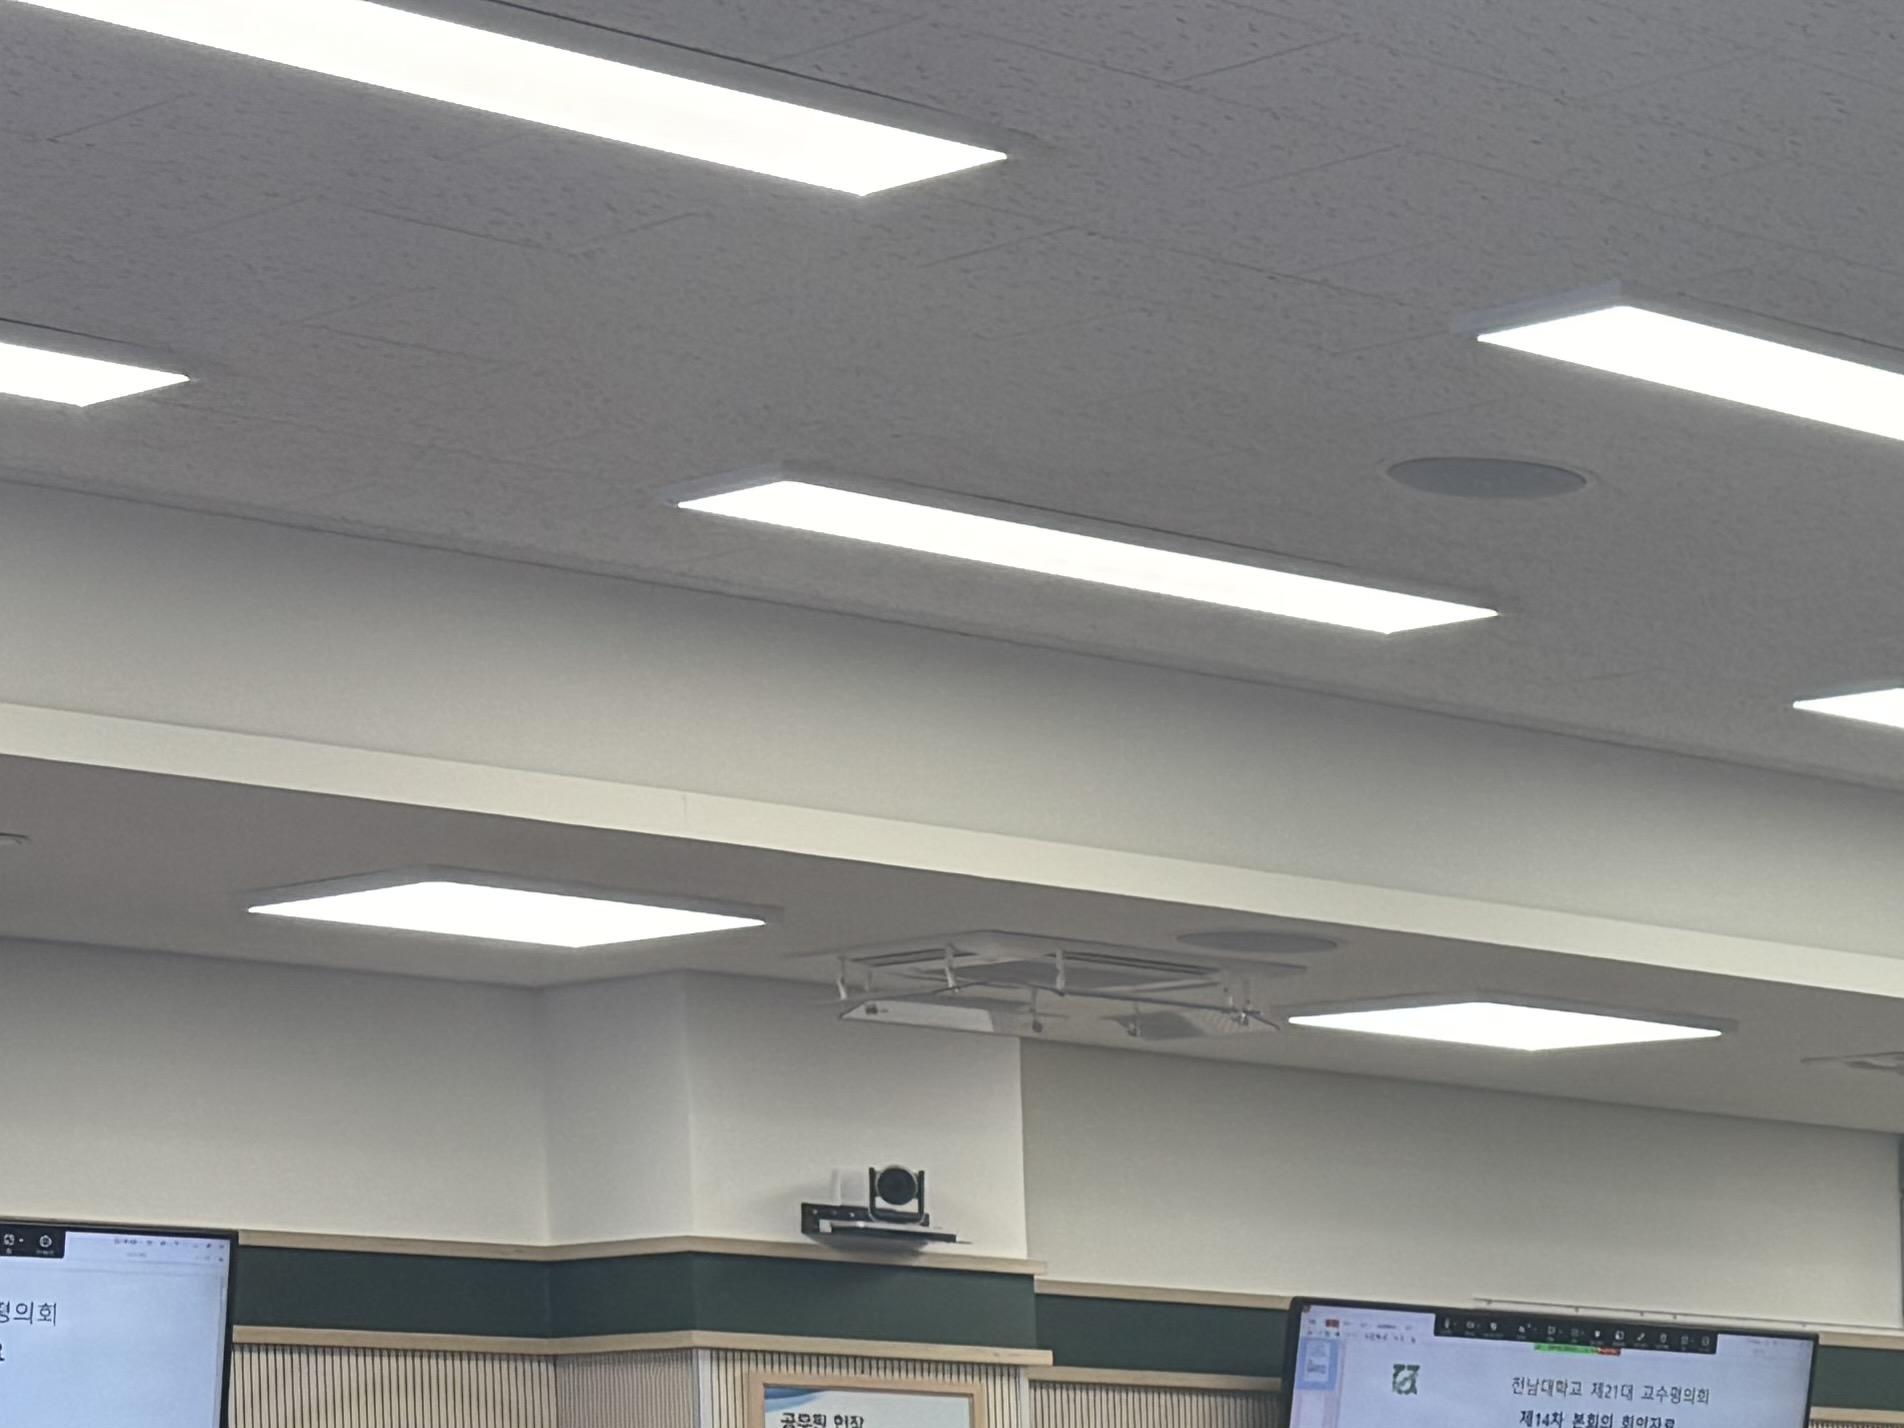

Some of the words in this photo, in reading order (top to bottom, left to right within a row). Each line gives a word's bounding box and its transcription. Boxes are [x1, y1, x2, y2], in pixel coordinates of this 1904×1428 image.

[1511, 1376, 1583, 1398] 전남대학교
[1590, 1381, 1634, 1401] 제21대
[1640, 1384, 1711, 1406] 교수평의회
